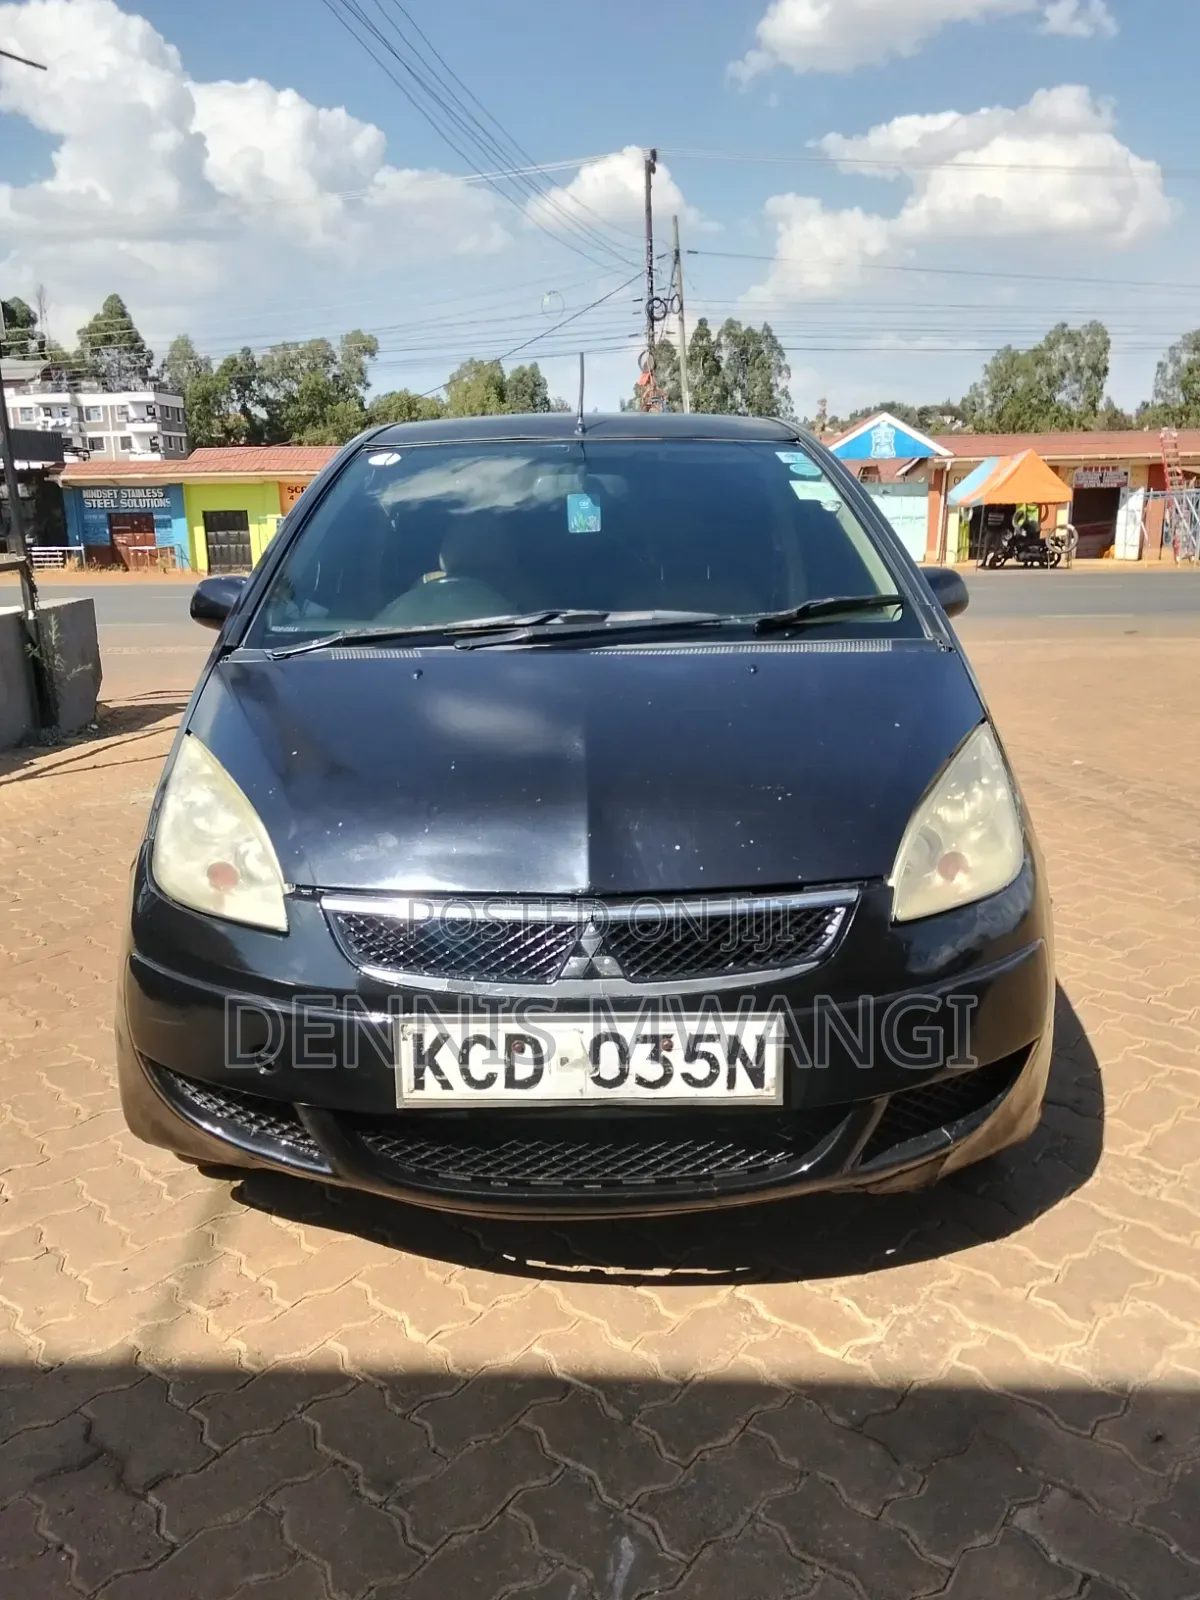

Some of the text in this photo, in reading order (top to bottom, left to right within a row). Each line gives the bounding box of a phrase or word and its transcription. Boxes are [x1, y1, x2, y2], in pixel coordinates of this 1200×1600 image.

[82, 488, 164, 499] MINDSET STAINLESS
[84, 498, 171, 508] STEEL SOLUTIONS
[412, 1031, 766, 1092] KCD 035N
